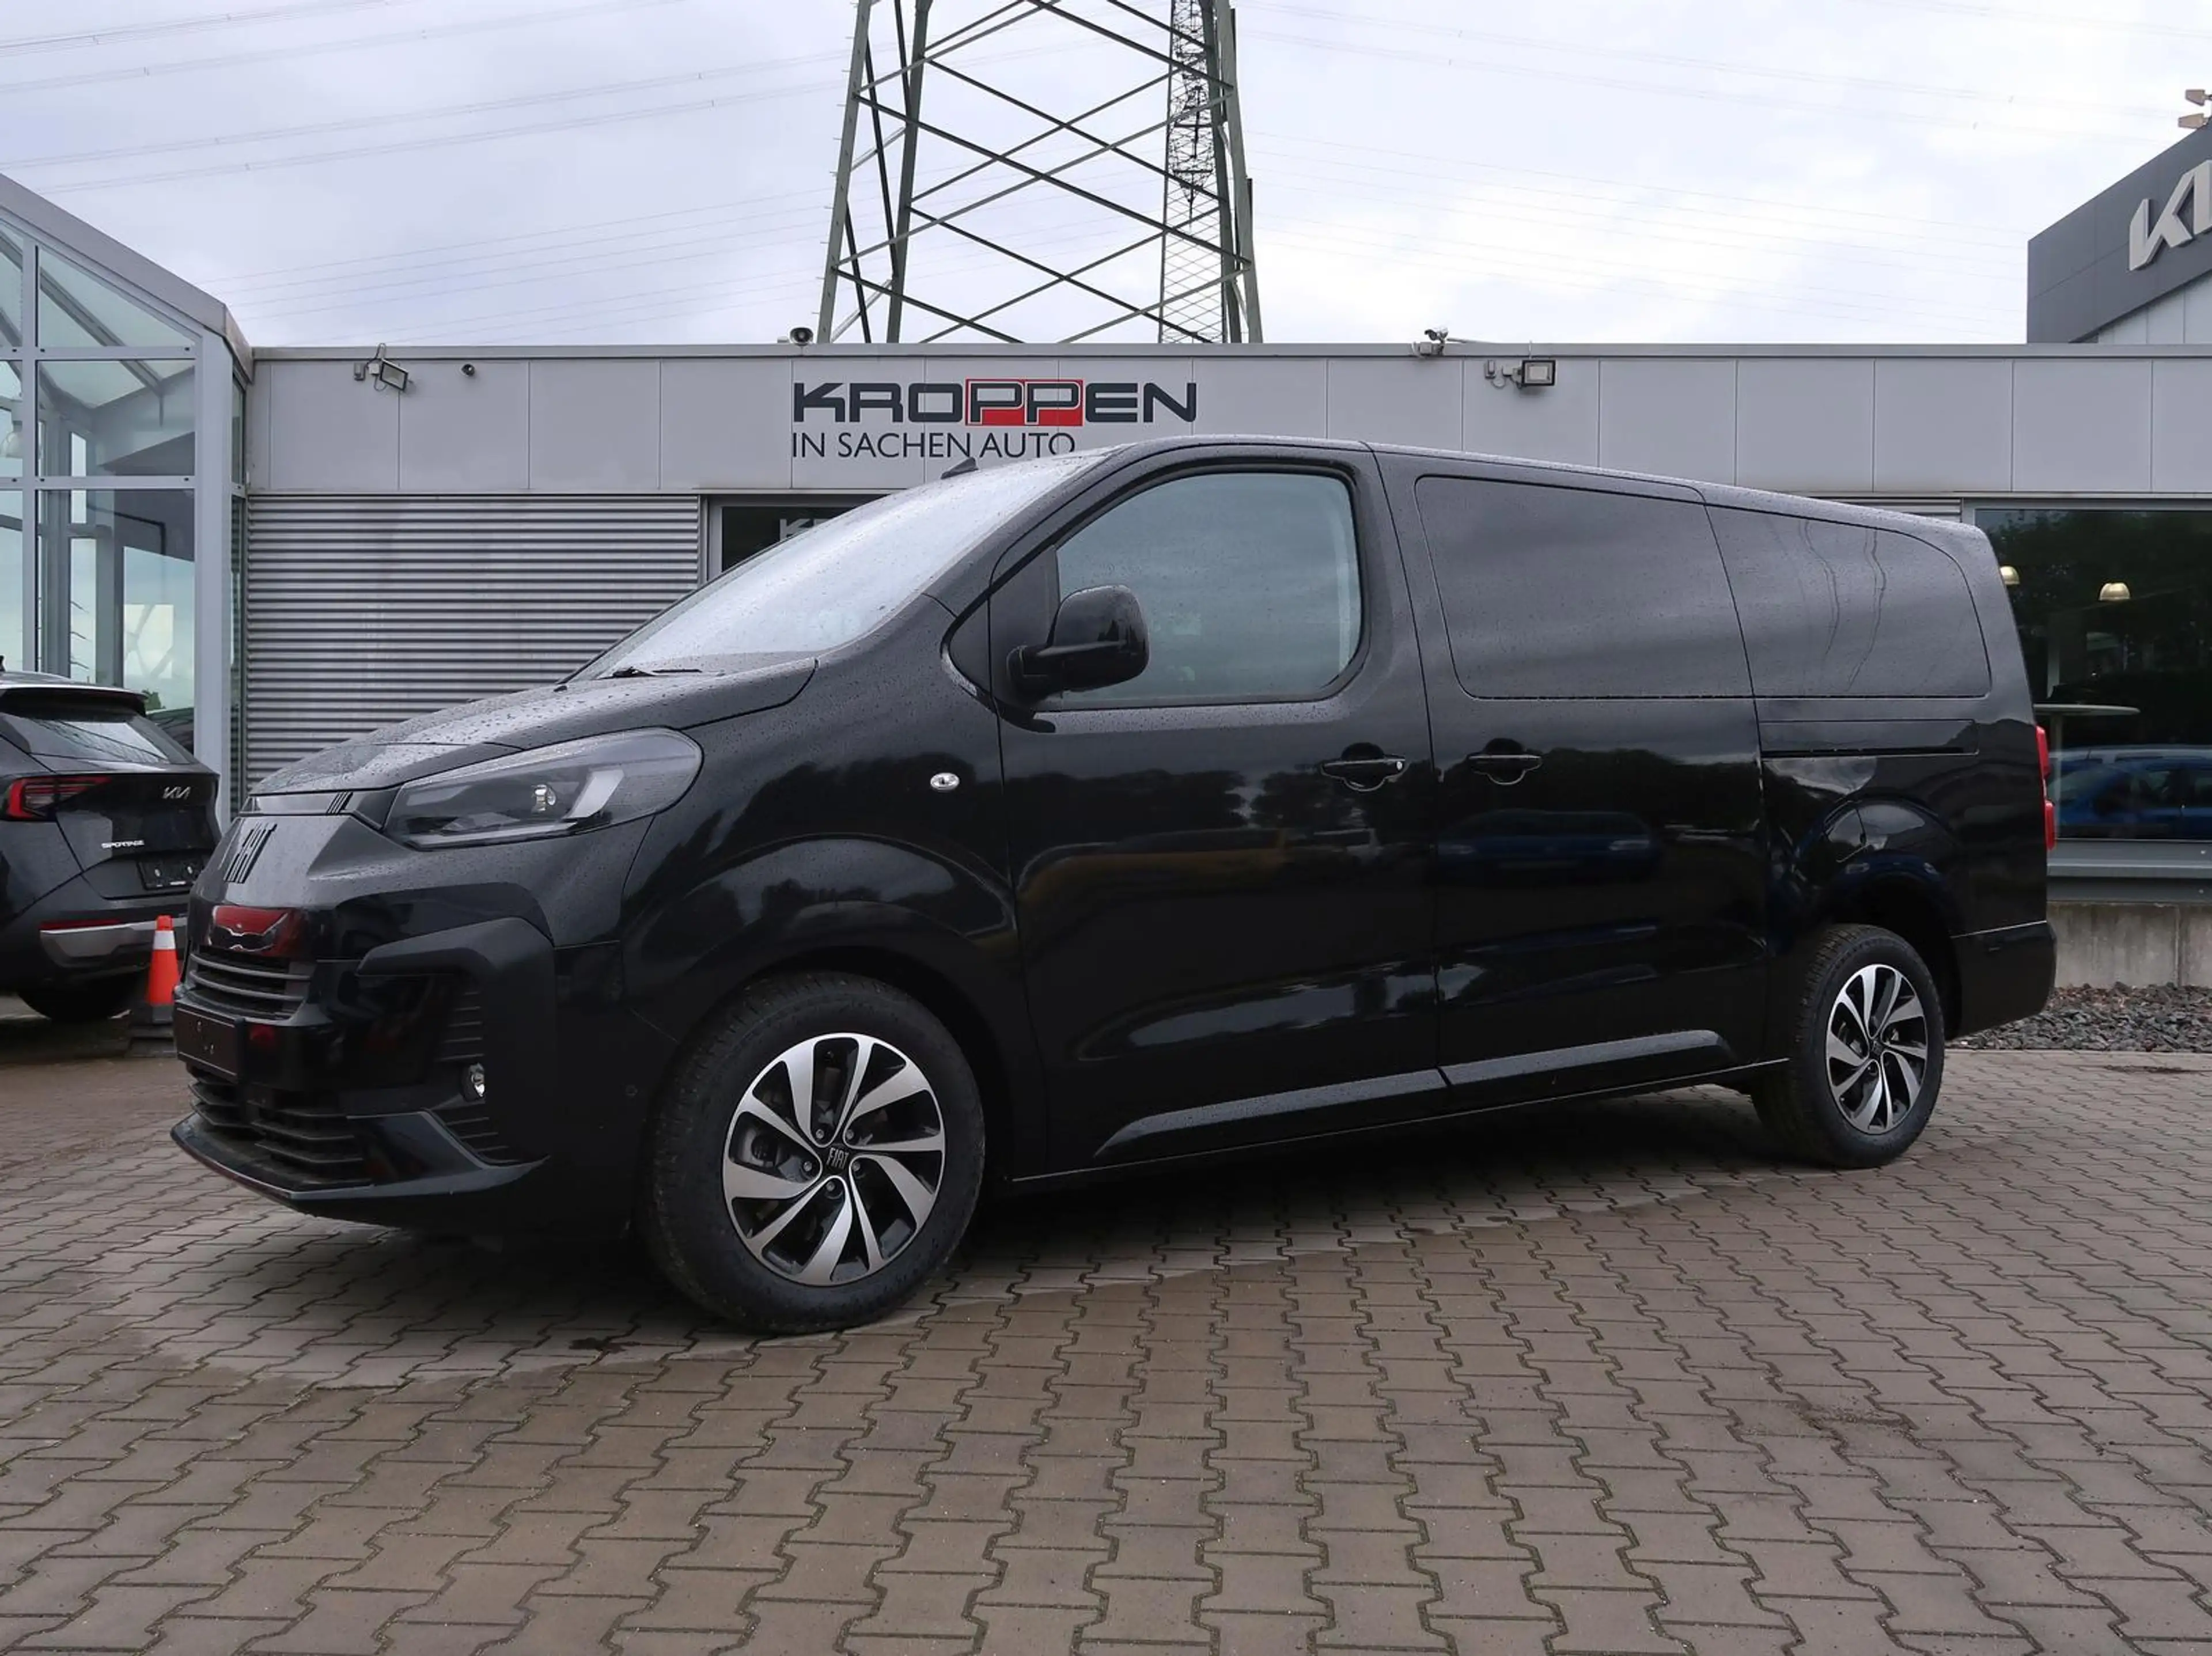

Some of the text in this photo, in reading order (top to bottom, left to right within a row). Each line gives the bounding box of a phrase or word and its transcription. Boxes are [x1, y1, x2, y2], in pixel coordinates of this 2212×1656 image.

[793, 381, 1197, 424] KROPPEN
[792, 431, 1075, 458] IN SACHEN AUTO
[825, 1147, 850, 1170] FIAT
